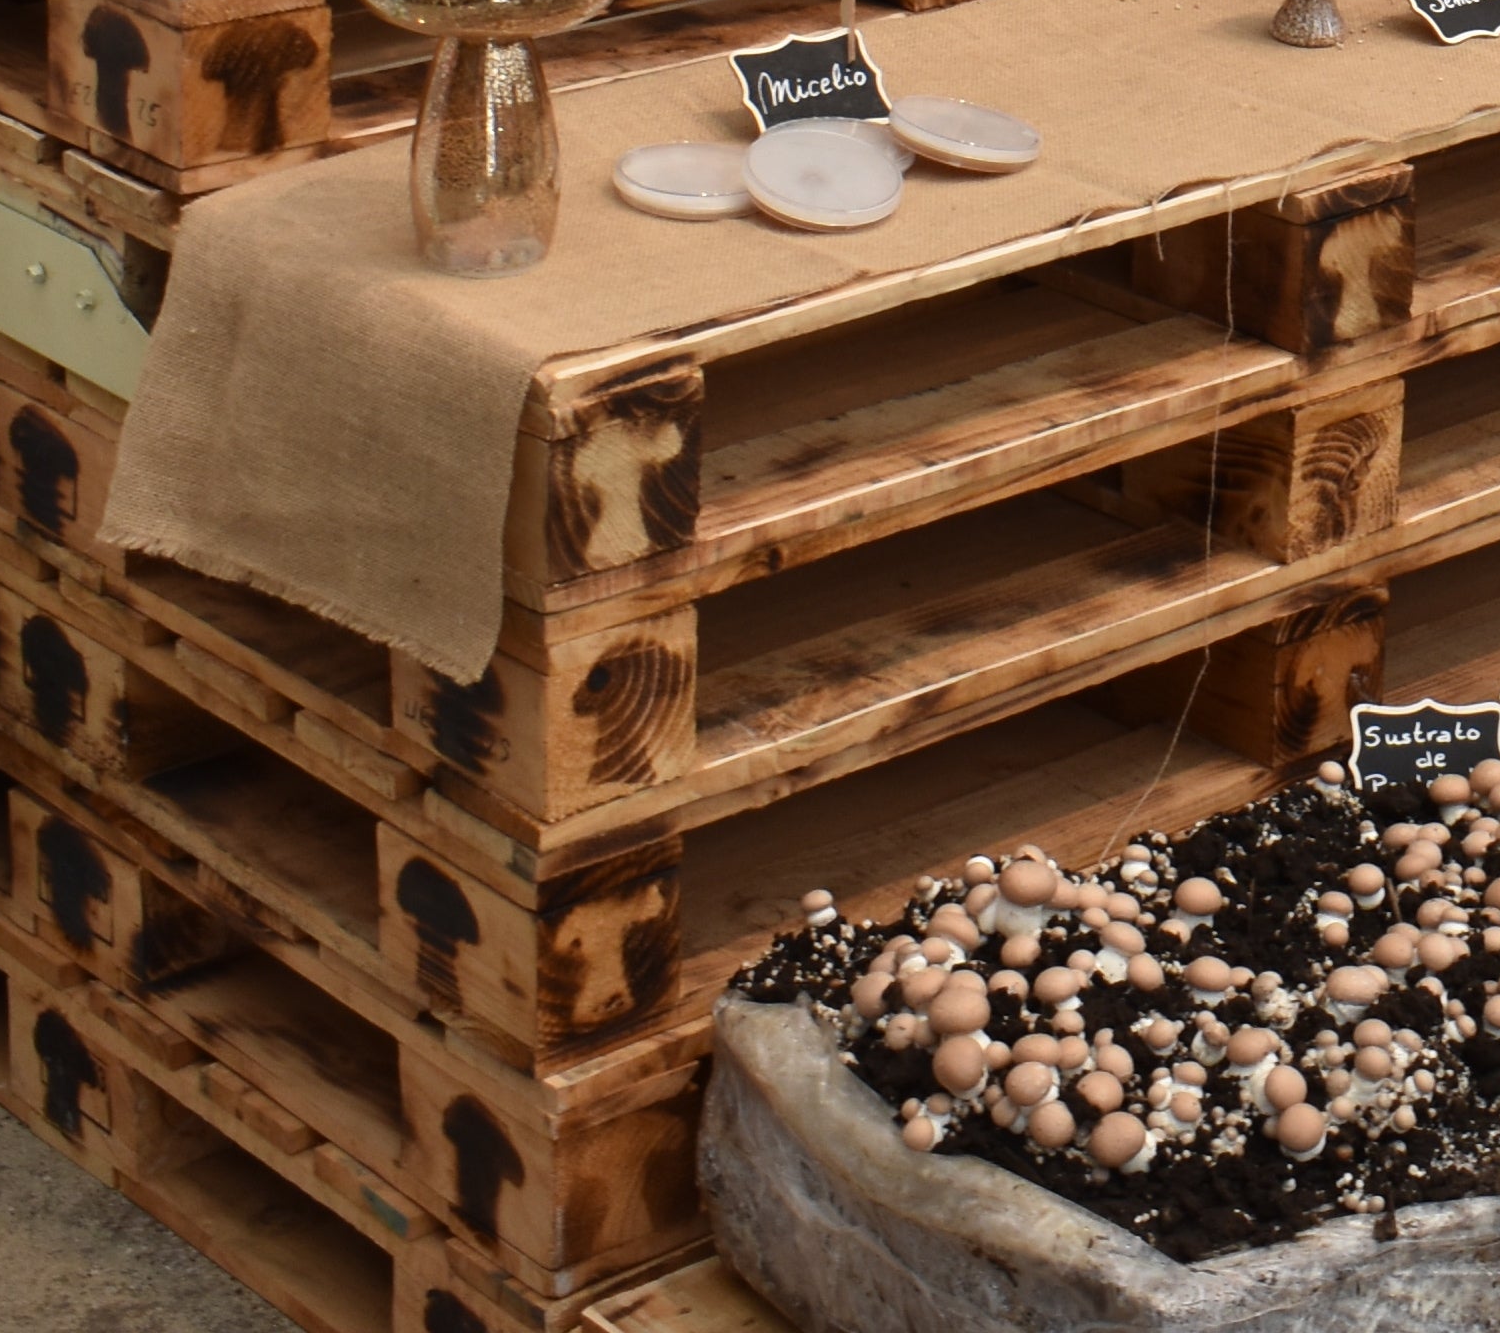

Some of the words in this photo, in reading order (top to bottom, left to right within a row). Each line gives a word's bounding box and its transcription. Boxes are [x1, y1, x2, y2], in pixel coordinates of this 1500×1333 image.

[757, 62, 868, 116] Micelio
[1363, 720, 1482, 748] Sustrato
[1414, 750, 1448, 769] de
